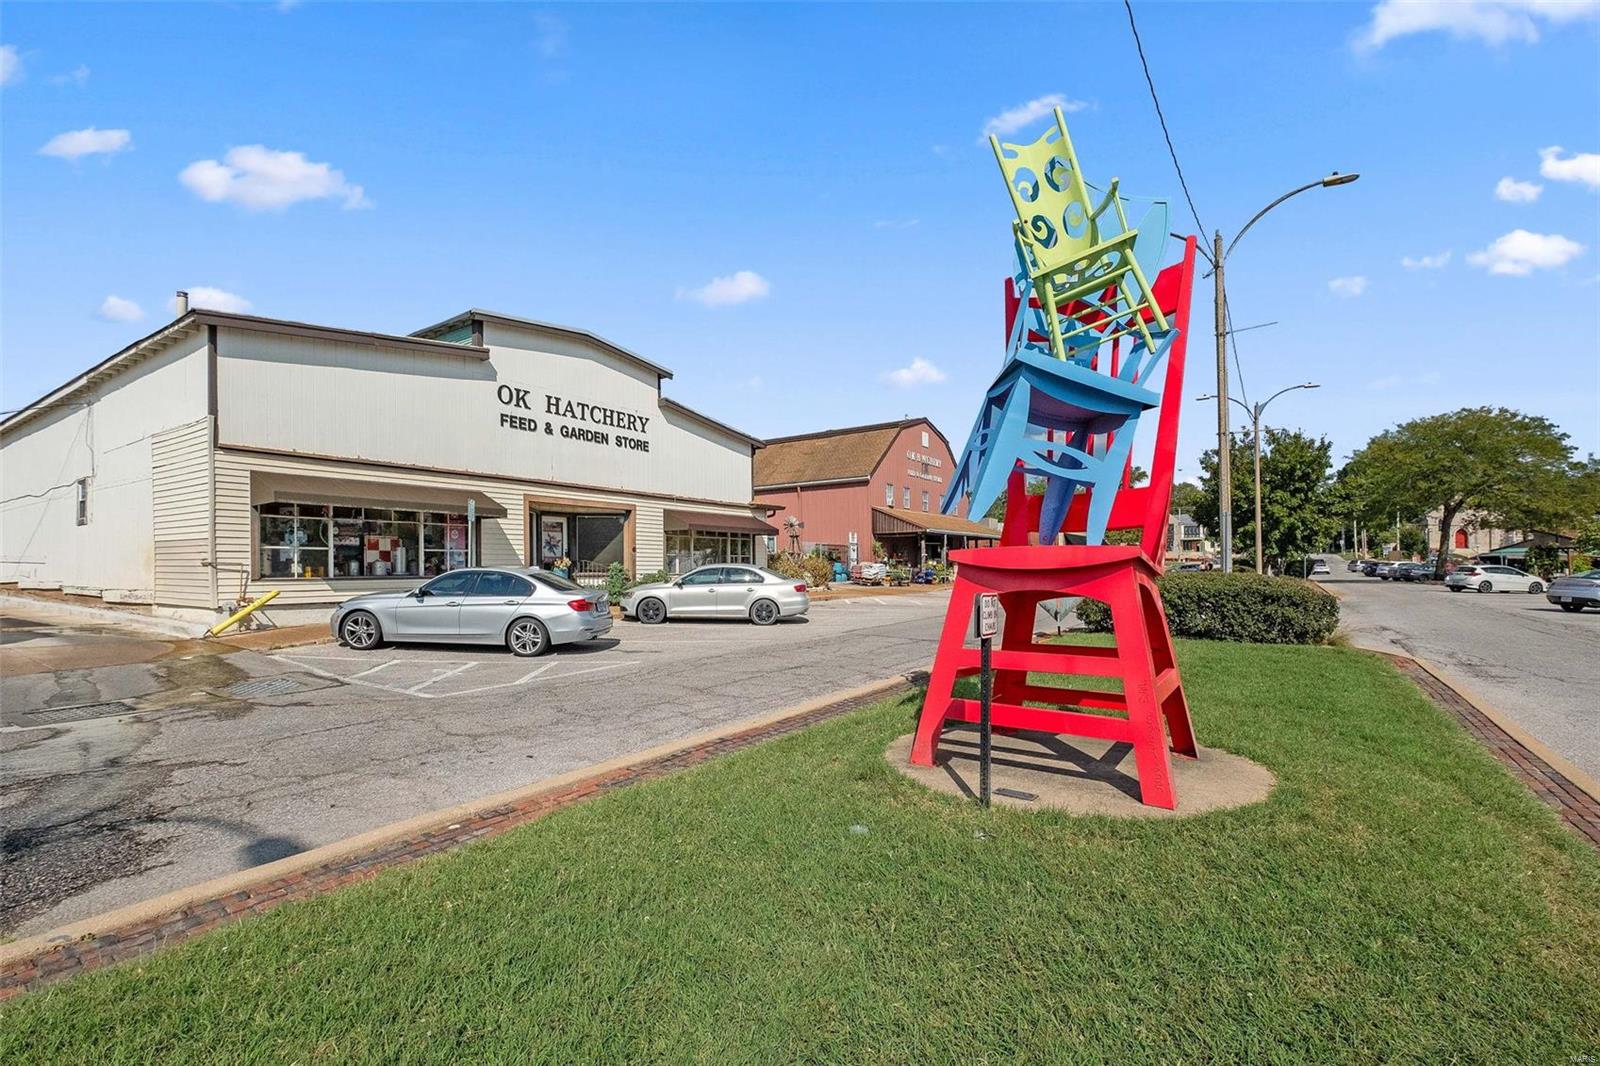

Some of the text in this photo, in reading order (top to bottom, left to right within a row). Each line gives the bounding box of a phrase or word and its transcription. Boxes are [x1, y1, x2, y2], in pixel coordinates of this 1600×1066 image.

[497, 384, 650, 434] OK HATCHERY
[500, 413, 650, 453] FEED & GARDEN STORE
